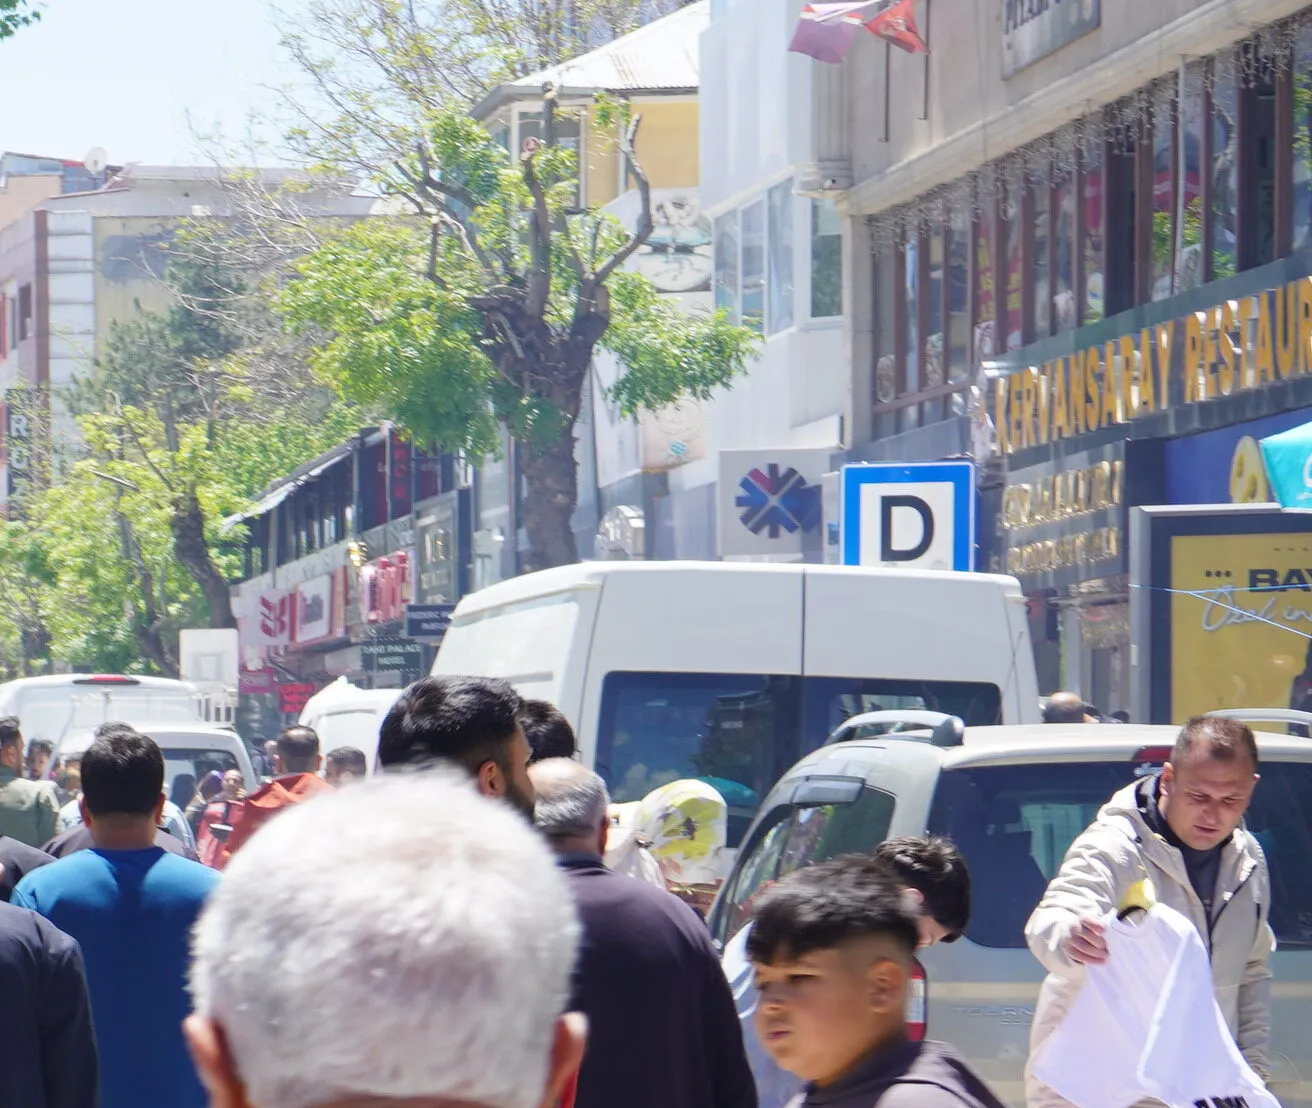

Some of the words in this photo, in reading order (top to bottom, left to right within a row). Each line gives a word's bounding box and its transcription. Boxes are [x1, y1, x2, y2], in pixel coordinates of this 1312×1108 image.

[995, 321, 1174, 456] KERVANSARAY
[1184, 274, 1312, 404] RESTAUR
[881, 495, 935, 561] D
